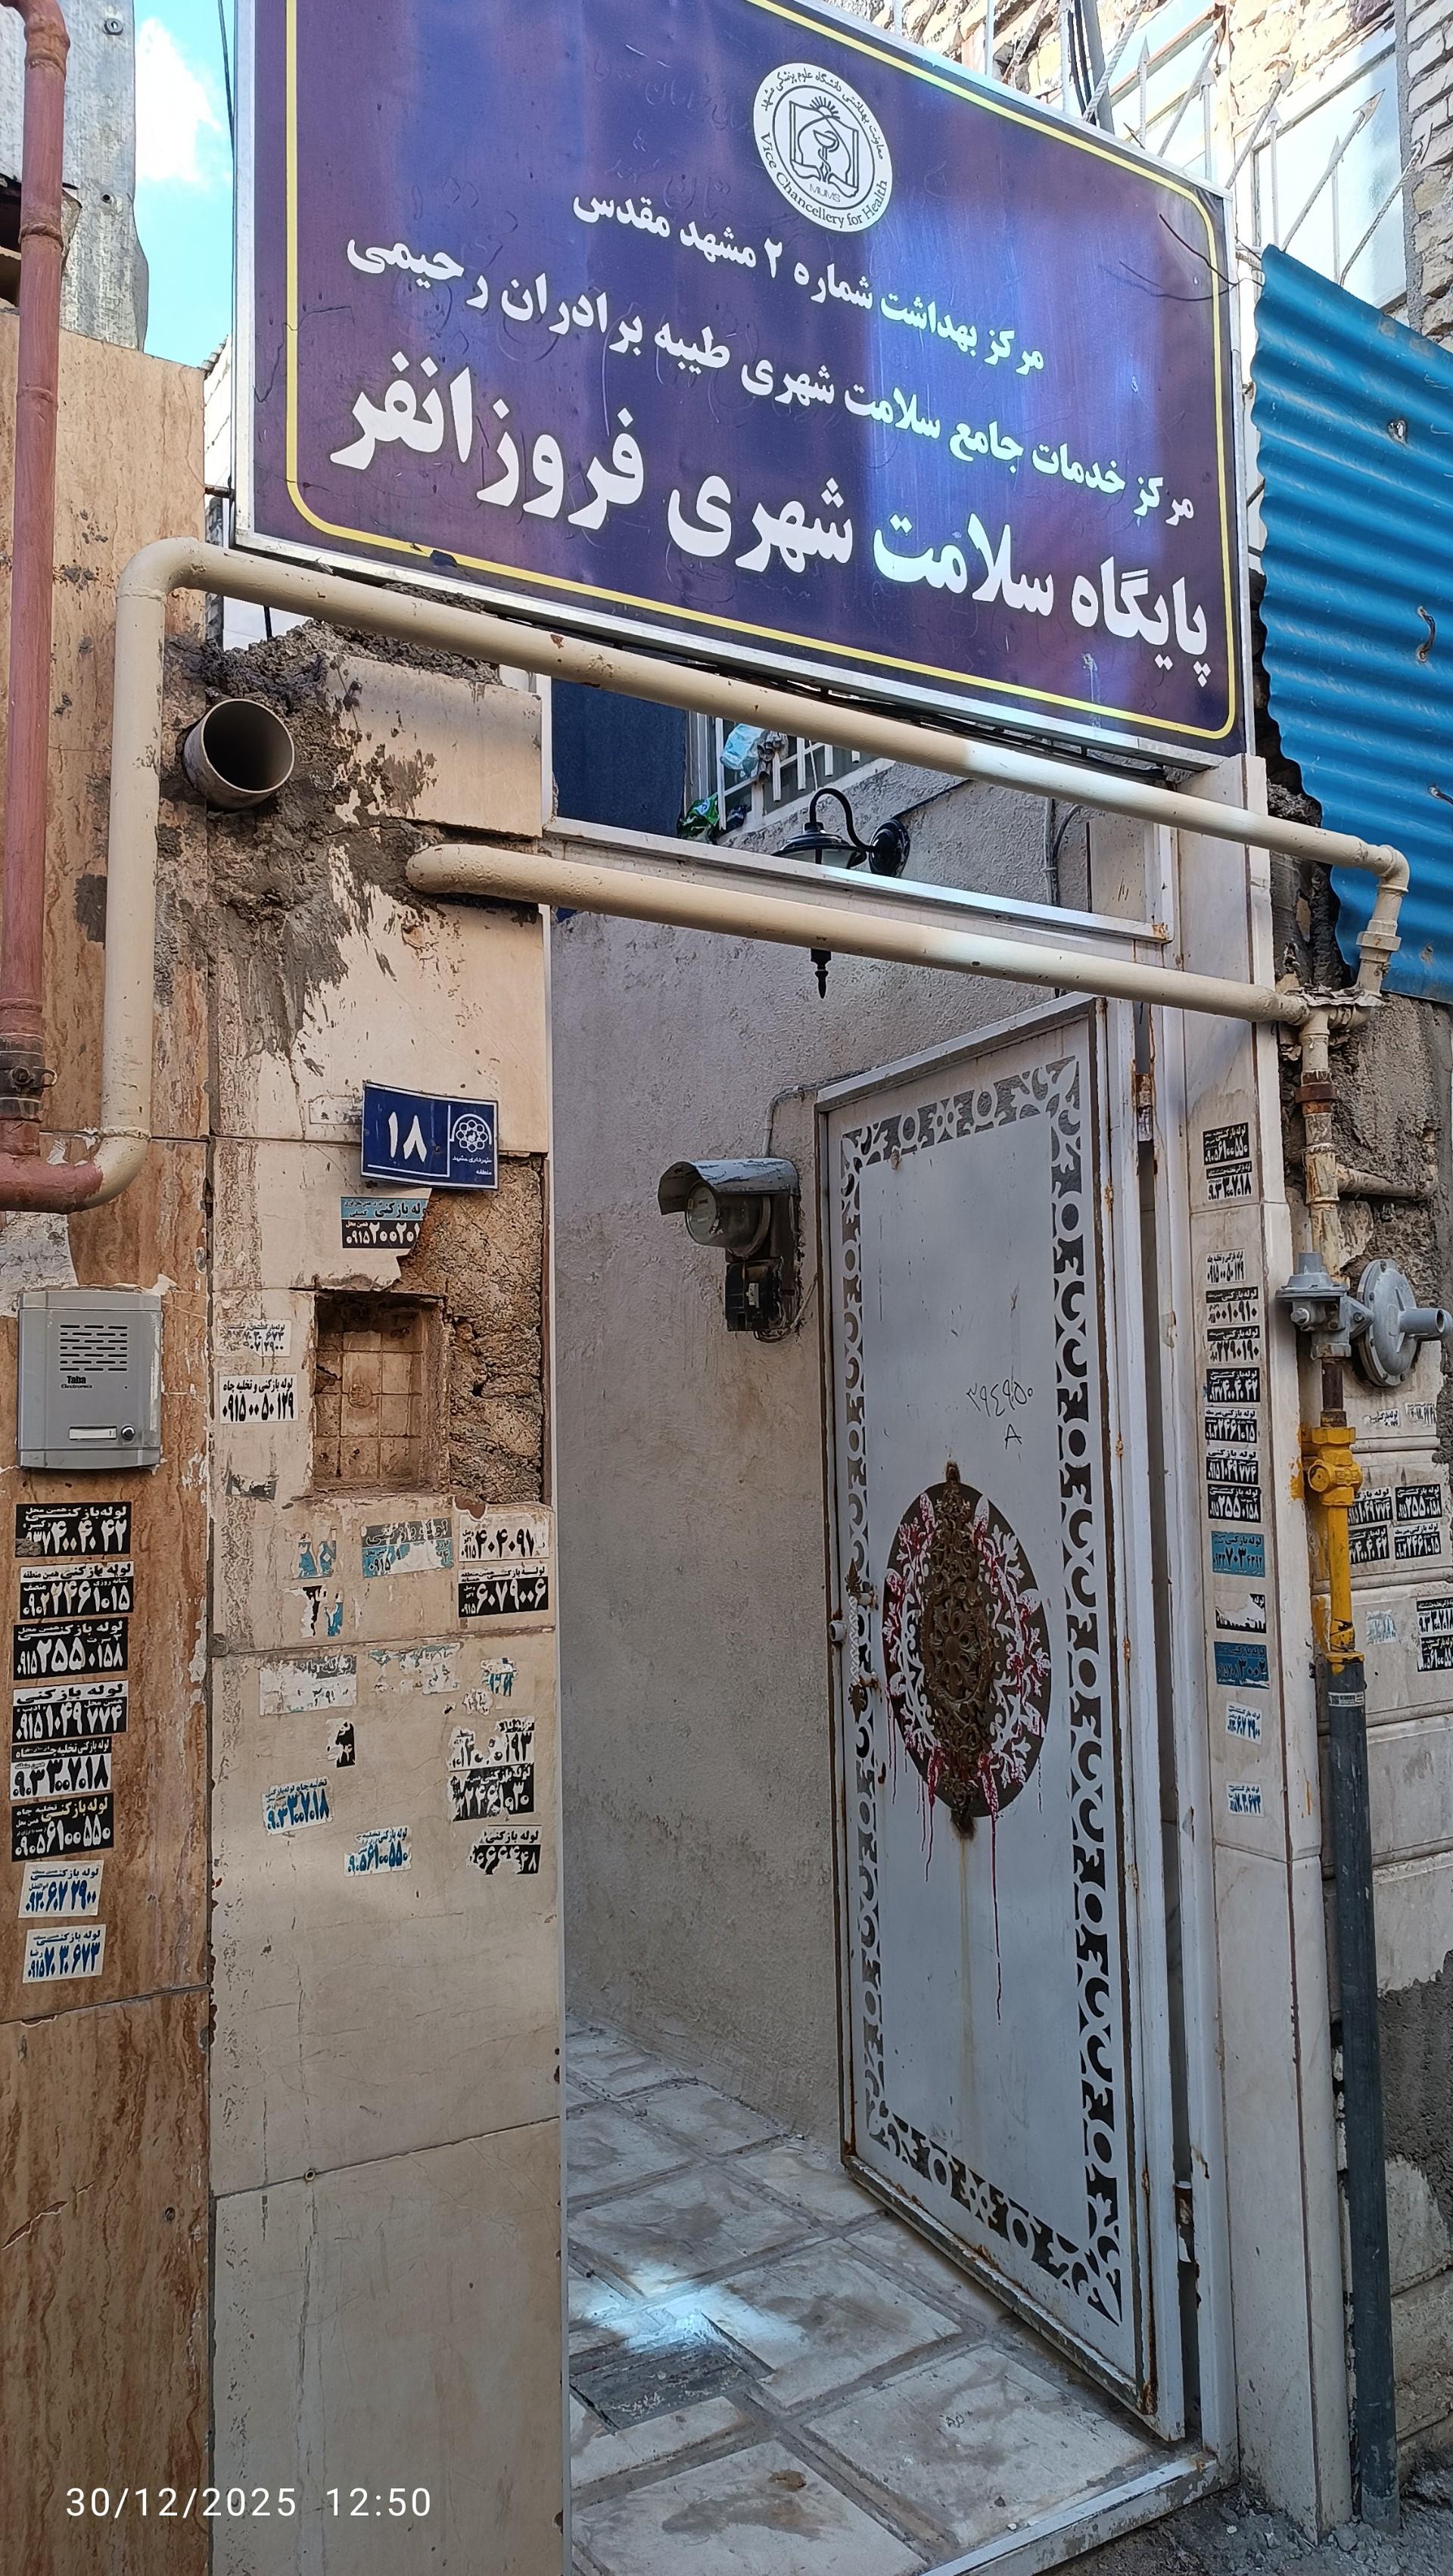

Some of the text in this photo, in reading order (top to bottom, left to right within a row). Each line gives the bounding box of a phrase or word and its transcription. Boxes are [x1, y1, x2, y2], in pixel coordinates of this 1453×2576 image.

[776, 71, 797, 92] پزشکی
[797, 67, 814, 82] علوم
[815, 72, 842, 92] دانشگاه
[761, 87, 774, 111] مشهد
[842, 94, 869, 124] بهداشتی
[761, 132, 777, 170] Vice
[776, 171, 845, 229] Chancellery
[847, 213, 863, 226] for
[862, 179, 888, 219] Health
[809, 182, 841, 203] MUMS
[573, 196, 1045, 376] مرکز بهداشت شماره ۲ مشهد مقدس
[347, 238, 1194, 526] مرکز خدمات جامع سلامت شهری طیبه برادران رحیمی
[329, 350, 1212, 687] پایگاه سلامت شهری فروزانفر
[388, 1112, 428, 1162] ۱۸
[223, 1377, 292, 1393] لوله بازکنی و تخلیه چاه
[101, 1506, 127, 1520] لوله
[25, 1519, 127, 1555] ۹۳۷۴۰۰۴۰۴۲
[107, 1563, 131, 1576] لوله
[96, 1620, 123, 1635] لوله
[17, 1684, 123, 1704] لوله بازکنی
[57, 1744, 77, 1756] تخلیه
[98, 1739, 109, 1752] لوله
[41, 1797, 107, 1822] لوله بازکنی
[486, 1830, 539, 1843] لوله بازکنی
[82, 1868, 99, 1878] لوله
[83, 1930, 101, 1940] لوله
